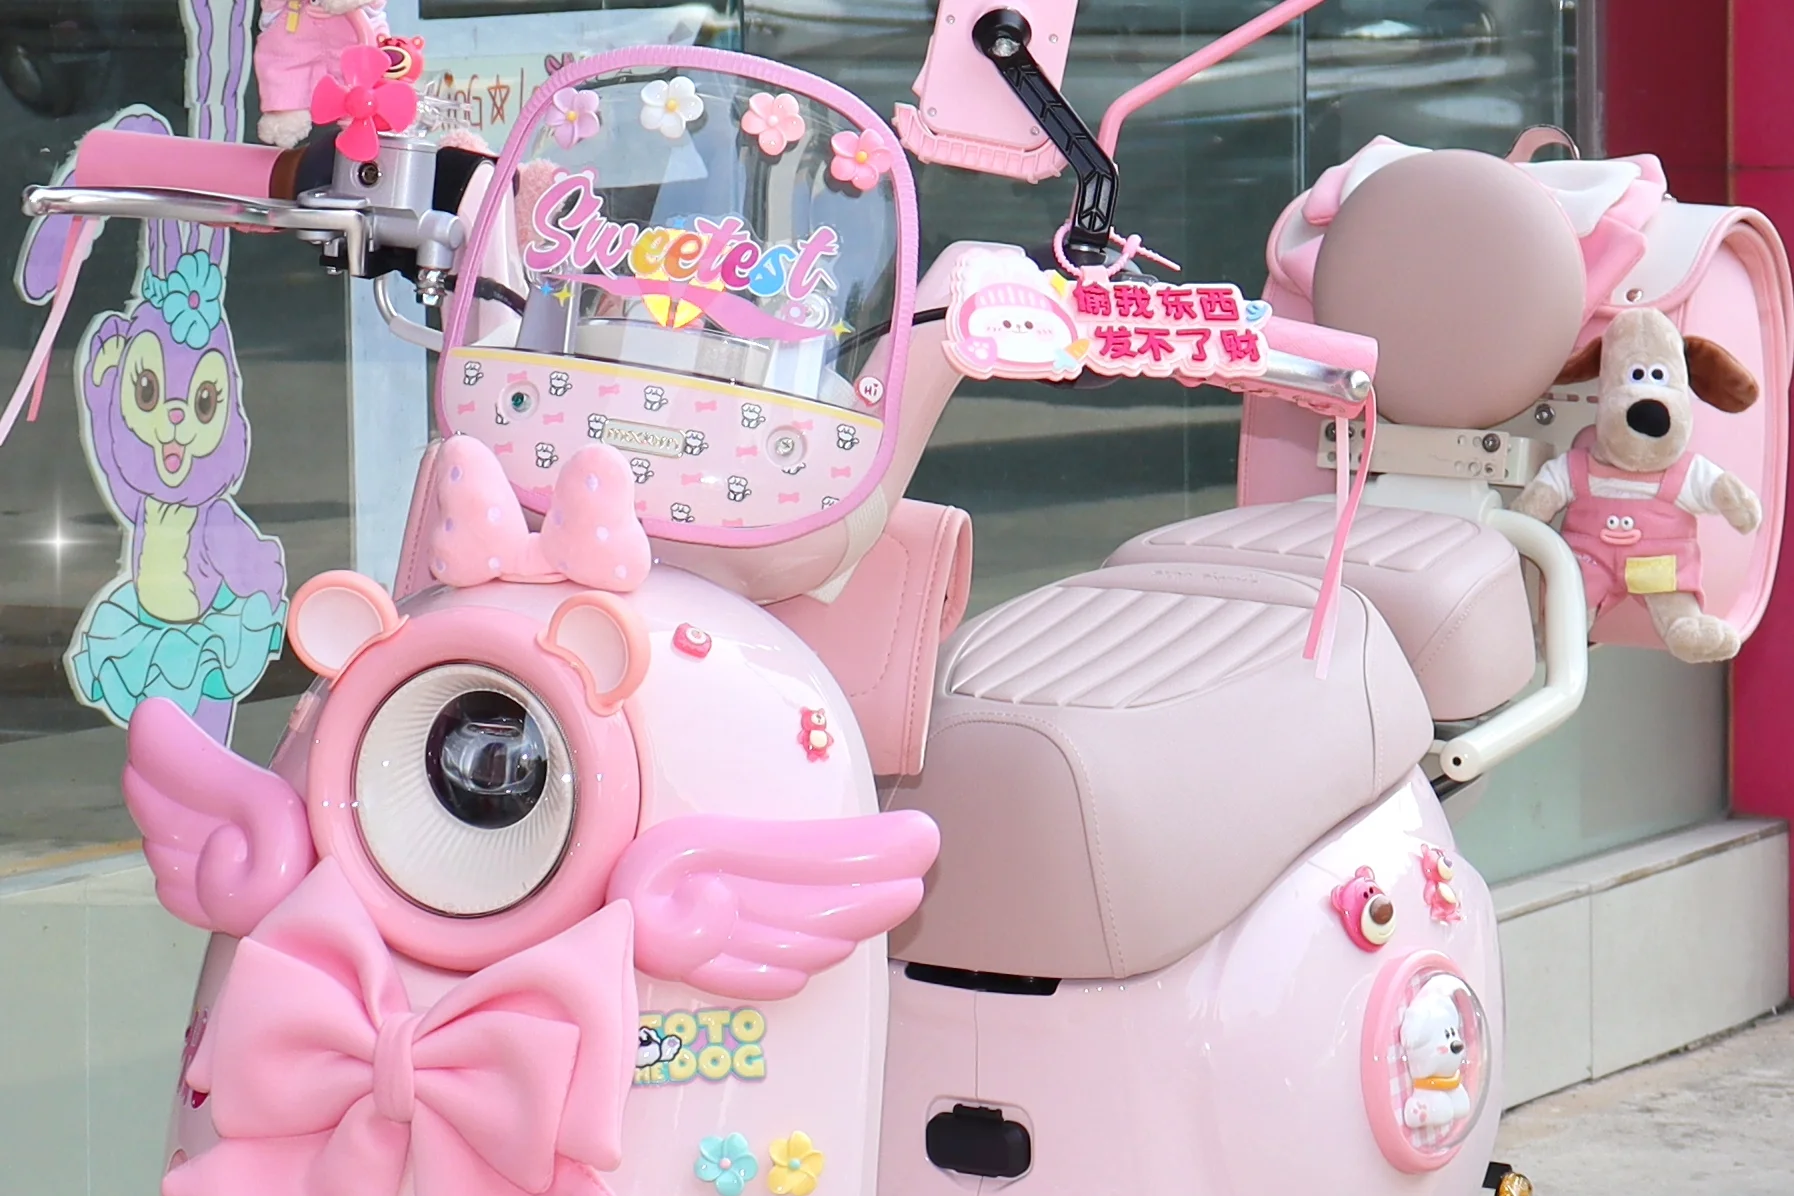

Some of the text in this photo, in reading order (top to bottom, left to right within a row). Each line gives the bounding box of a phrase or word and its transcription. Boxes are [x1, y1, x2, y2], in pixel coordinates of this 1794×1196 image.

[524, 174, 839, 301] Sweetest
[1073, 281, 1240, 321] 偷我东西
[1094, 326, 1260, 363] 发不了财
[864, 383, 879, 397] Hi
[668, 1043, 766, 1082] DOG
